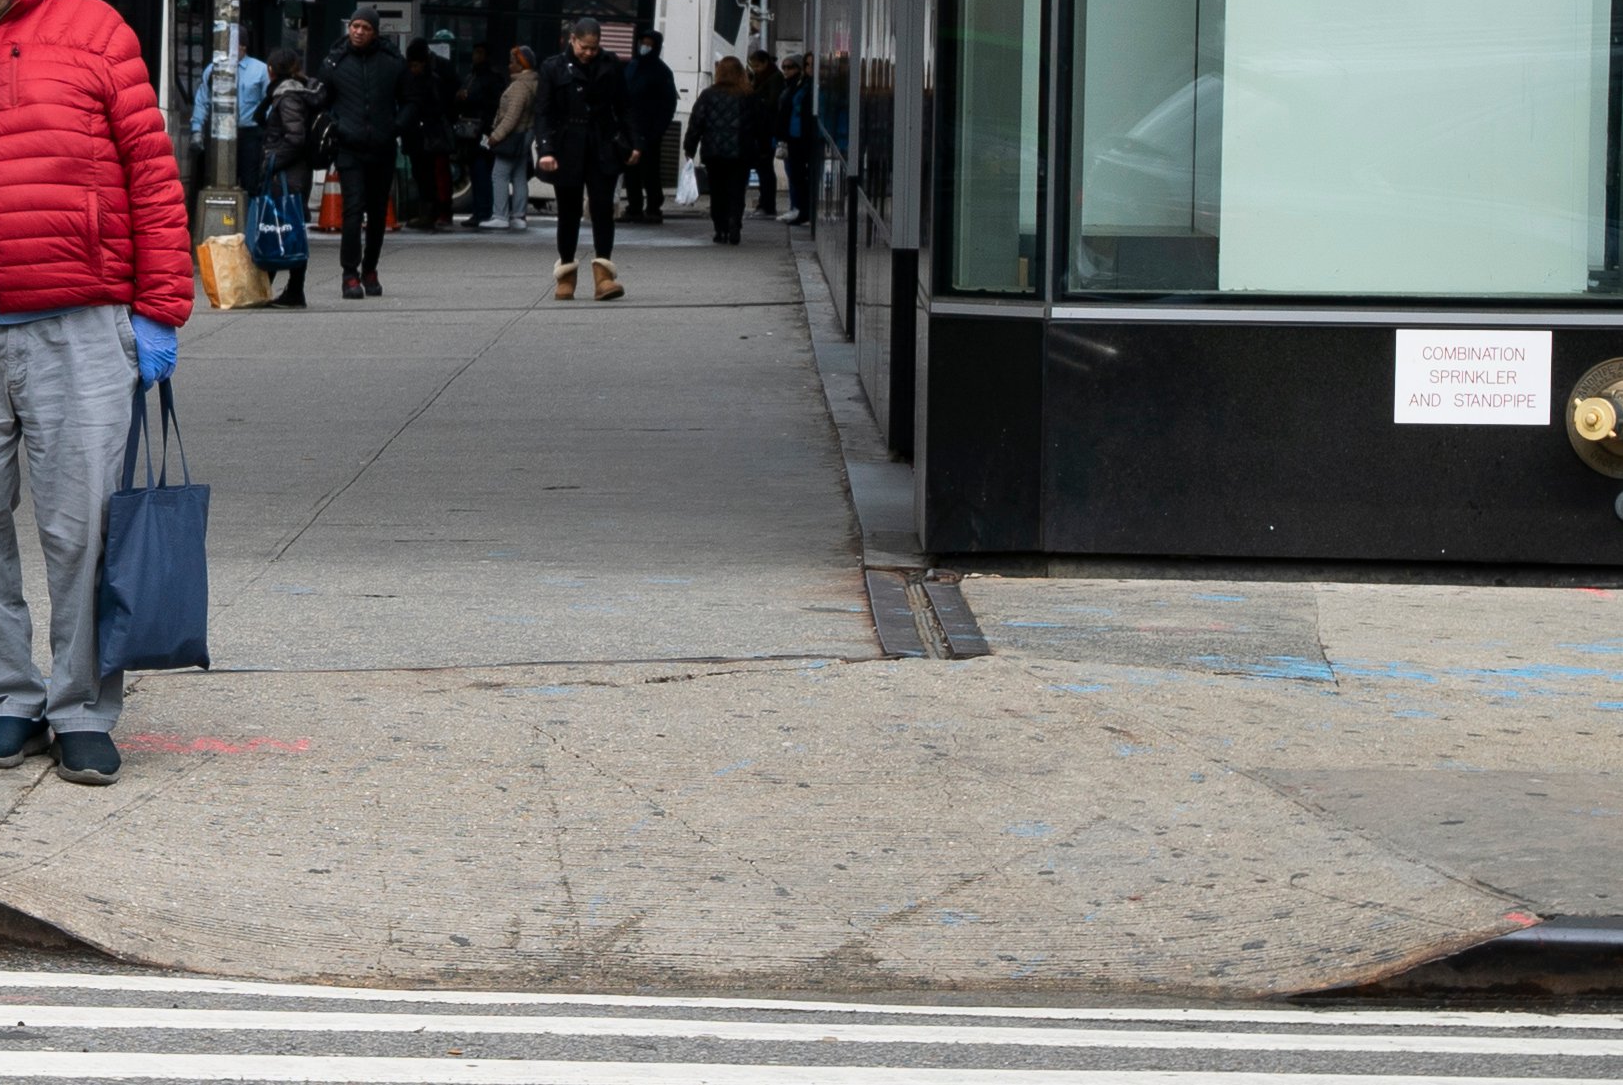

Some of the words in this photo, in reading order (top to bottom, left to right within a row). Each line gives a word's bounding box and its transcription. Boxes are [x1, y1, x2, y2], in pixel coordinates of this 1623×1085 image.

[1422, 346, 1526, 362] COMBINATION
[1429, 370, 1517, 385] SPRINKLER
[1408, 393, 1442, 407] AND
[1454, 393, 1537, 409] STANDPIPE
